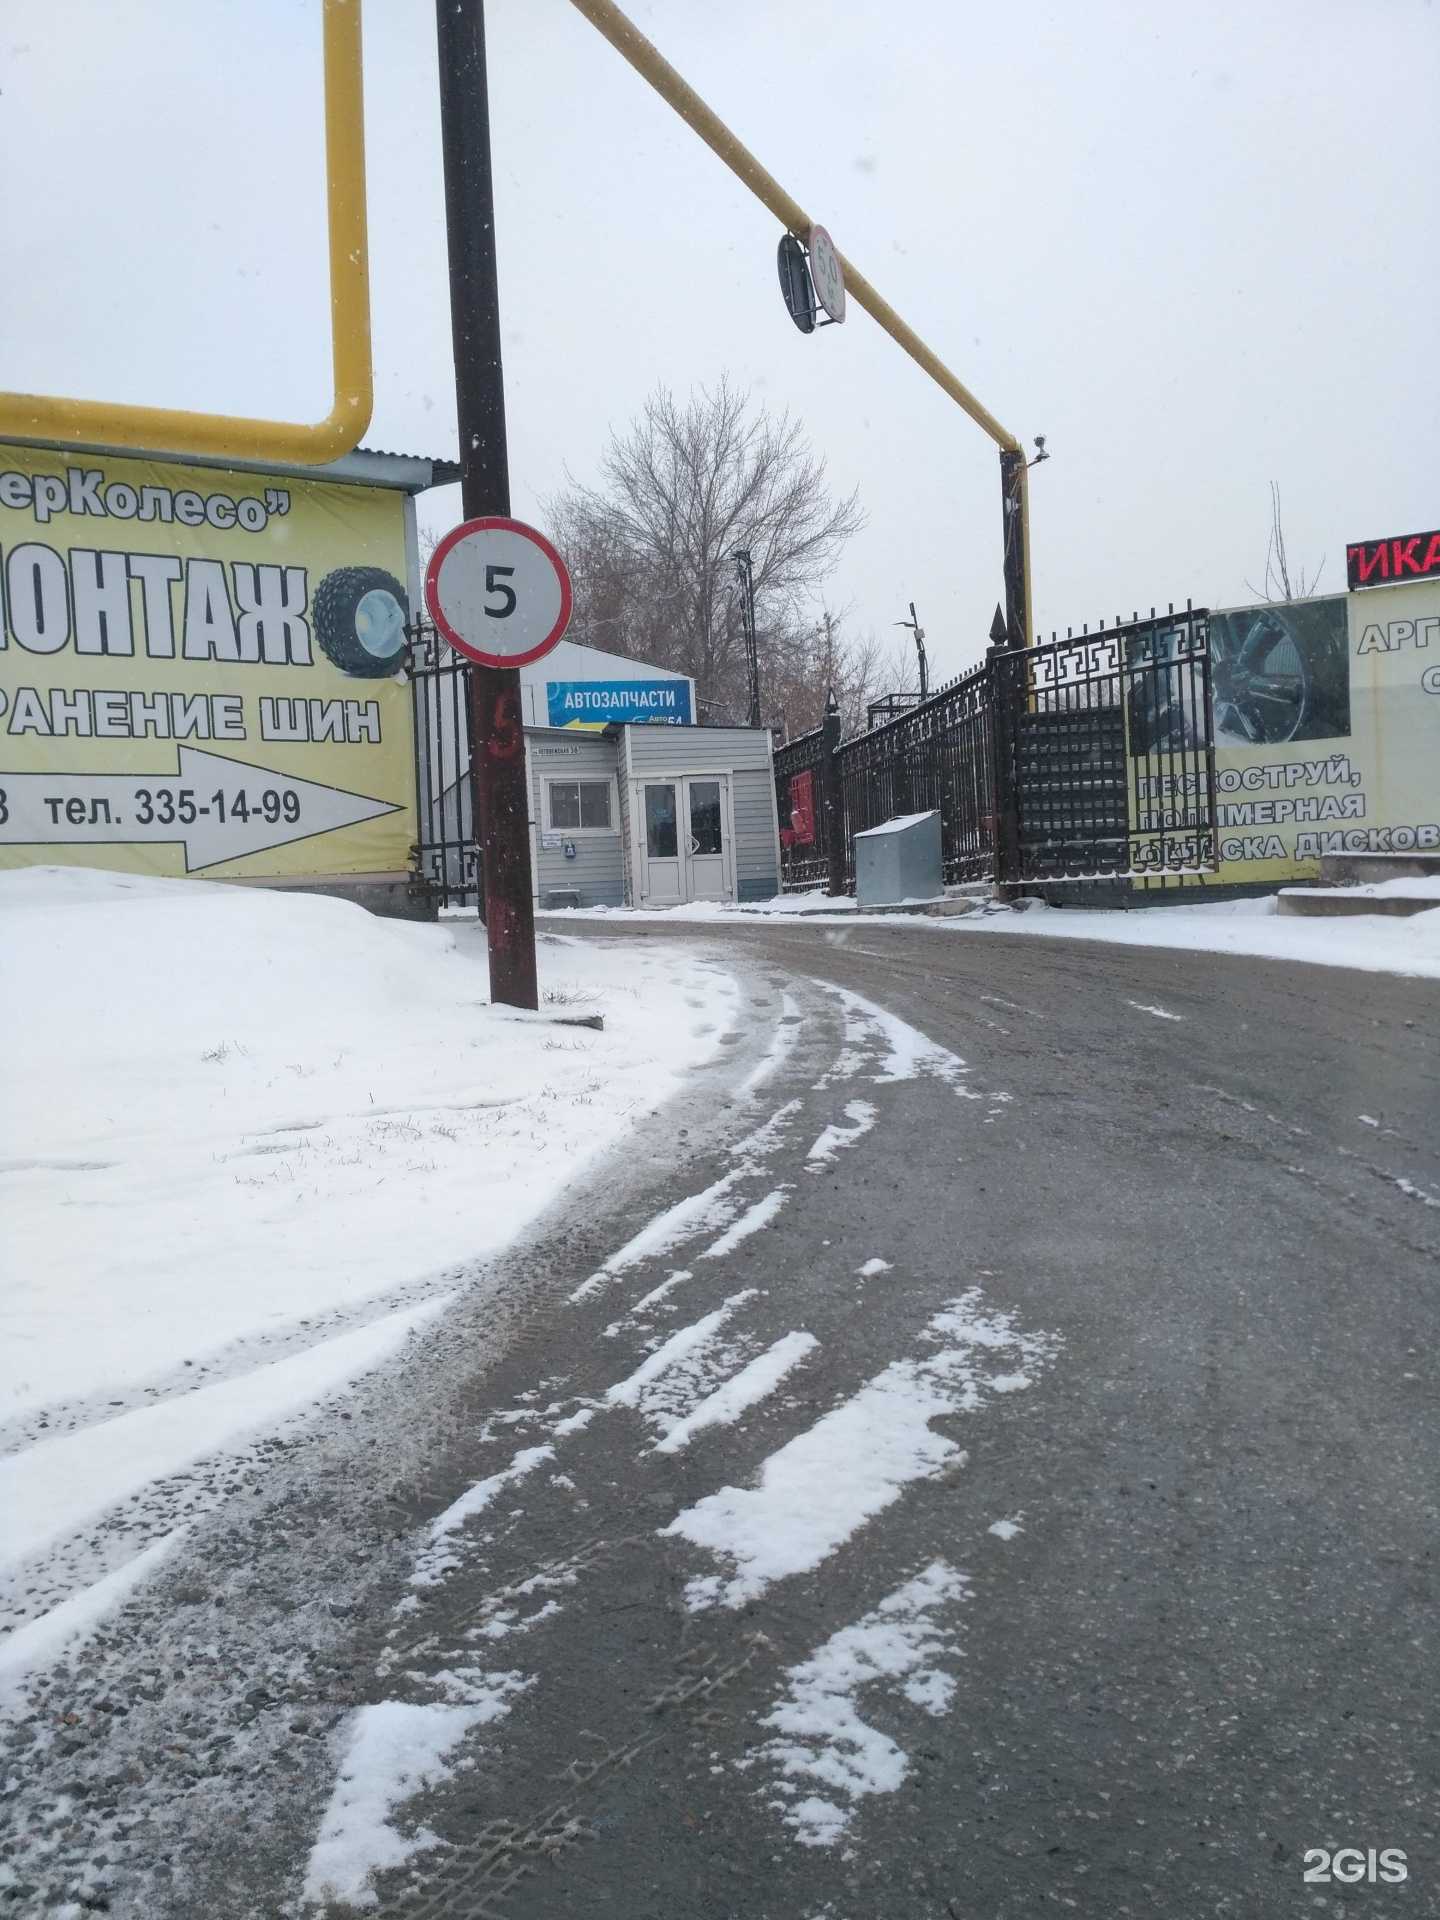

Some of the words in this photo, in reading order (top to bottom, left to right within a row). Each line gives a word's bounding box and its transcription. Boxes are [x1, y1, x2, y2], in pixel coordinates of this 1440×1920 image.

[0, 543, 314, 666] ОНТАЖ
[484, 565, 517, 618] 5
[0, 687, 246, 740] АНЕНИЕ
[259, 697, 382, 744] ШИН
[564, 690, 676, 709] АВТОЗАПЧАСТИ
[44, 797, 122, 825] тел.
[134, 789, 301, 826] 335-14-99
[1295, 825, 1440, 861] ДИСКОВ
